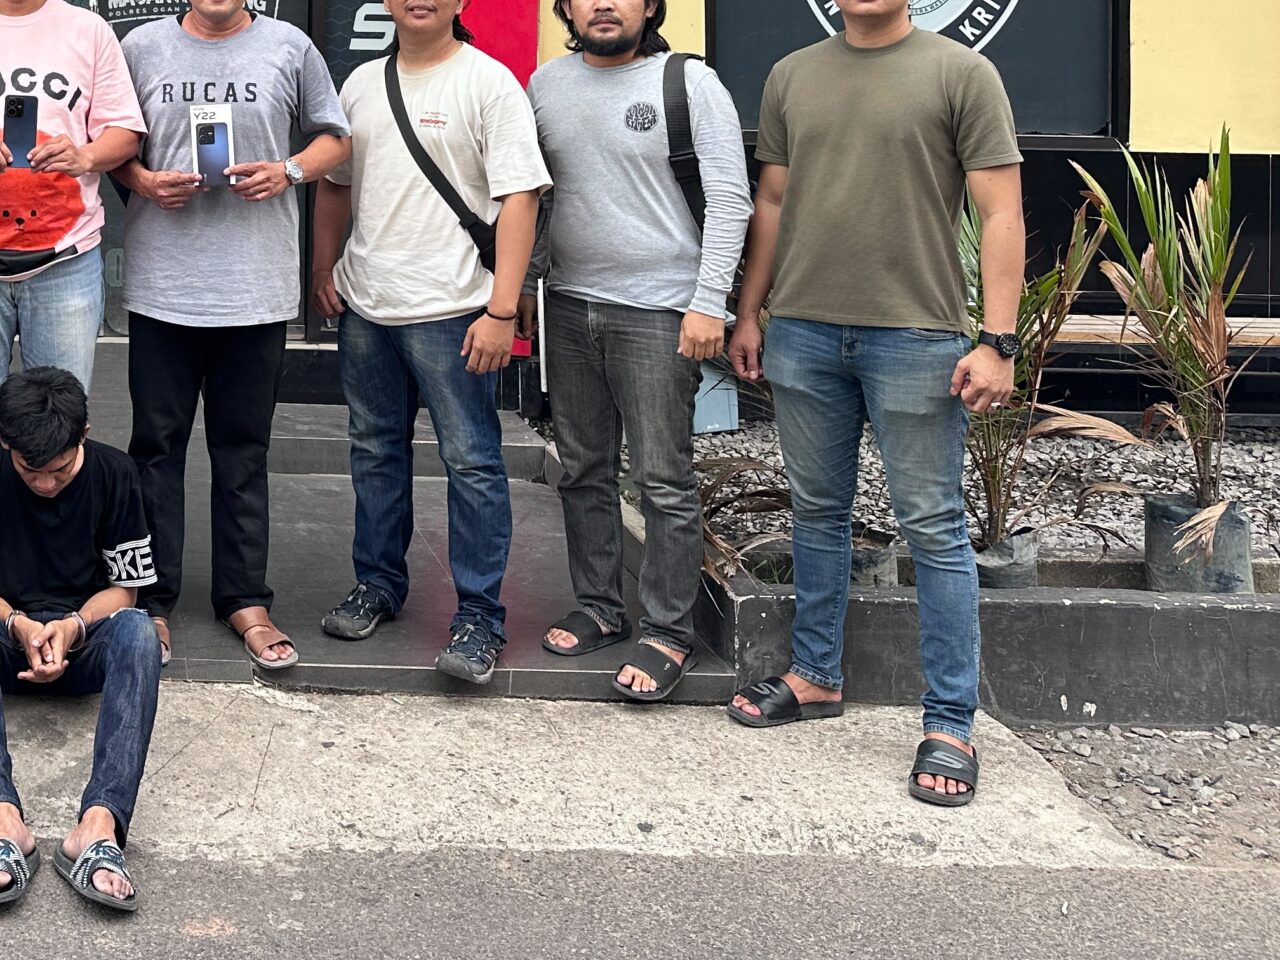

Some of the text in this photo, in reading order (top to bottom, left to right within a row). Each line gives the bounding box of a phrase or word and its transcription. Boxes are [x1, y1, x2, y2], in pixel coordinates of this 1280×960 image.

[108, 7, 147, 18] POLRES
[152, 5, 181, 14] OGAN
[161, 81, 258, 104] RUCAS
[193, 111, 216, 120] Y22
